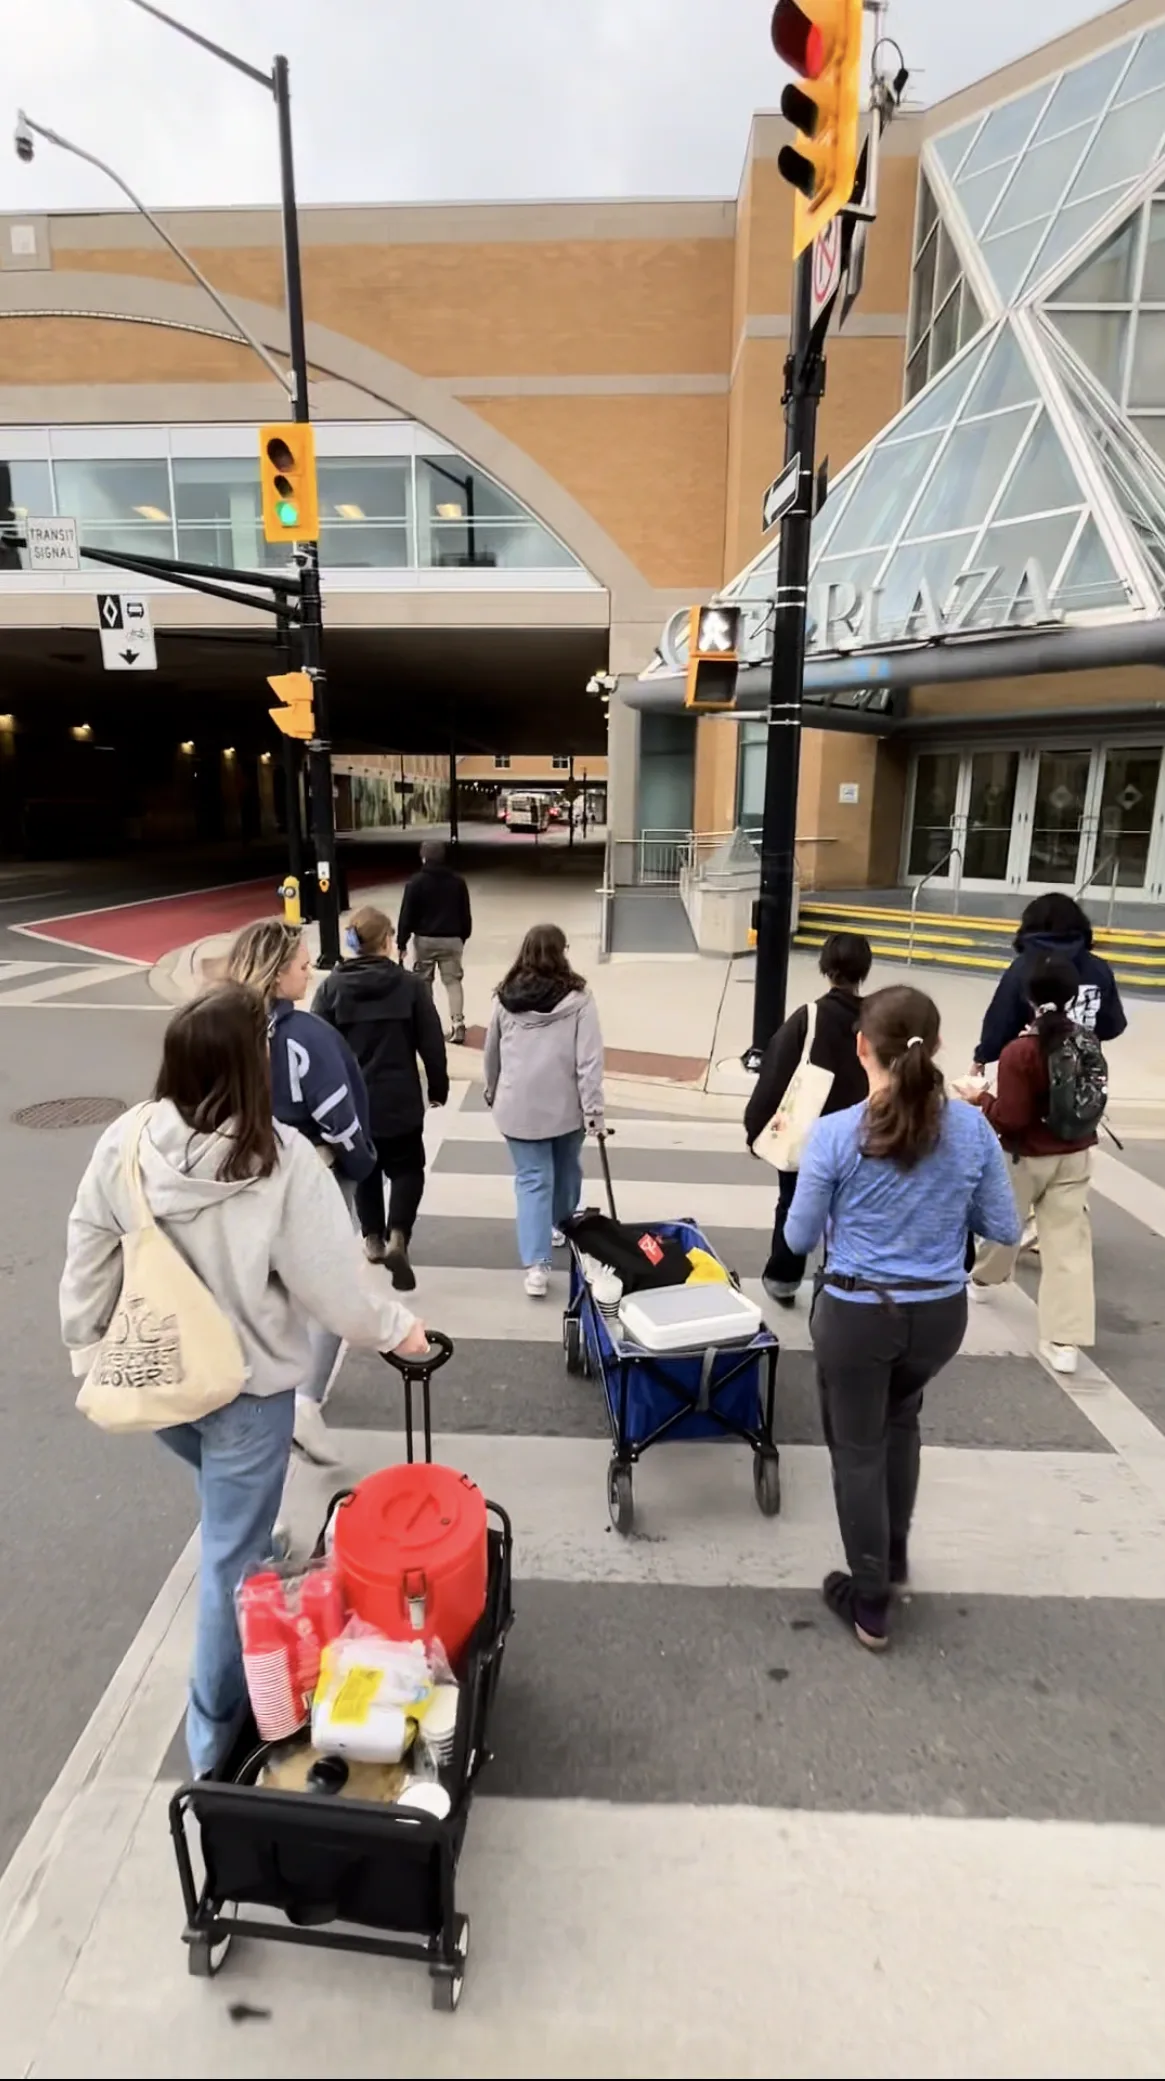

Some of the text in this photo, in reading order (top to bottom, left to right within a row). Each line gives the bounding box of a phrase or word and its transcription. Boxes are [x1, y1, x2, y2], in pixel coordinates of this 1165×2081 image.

[30, 528, 74, 541] TRANSIT
[34, 546, 74, 559] SIGNAL
[812, 557, 1067, 651] PLAZA
